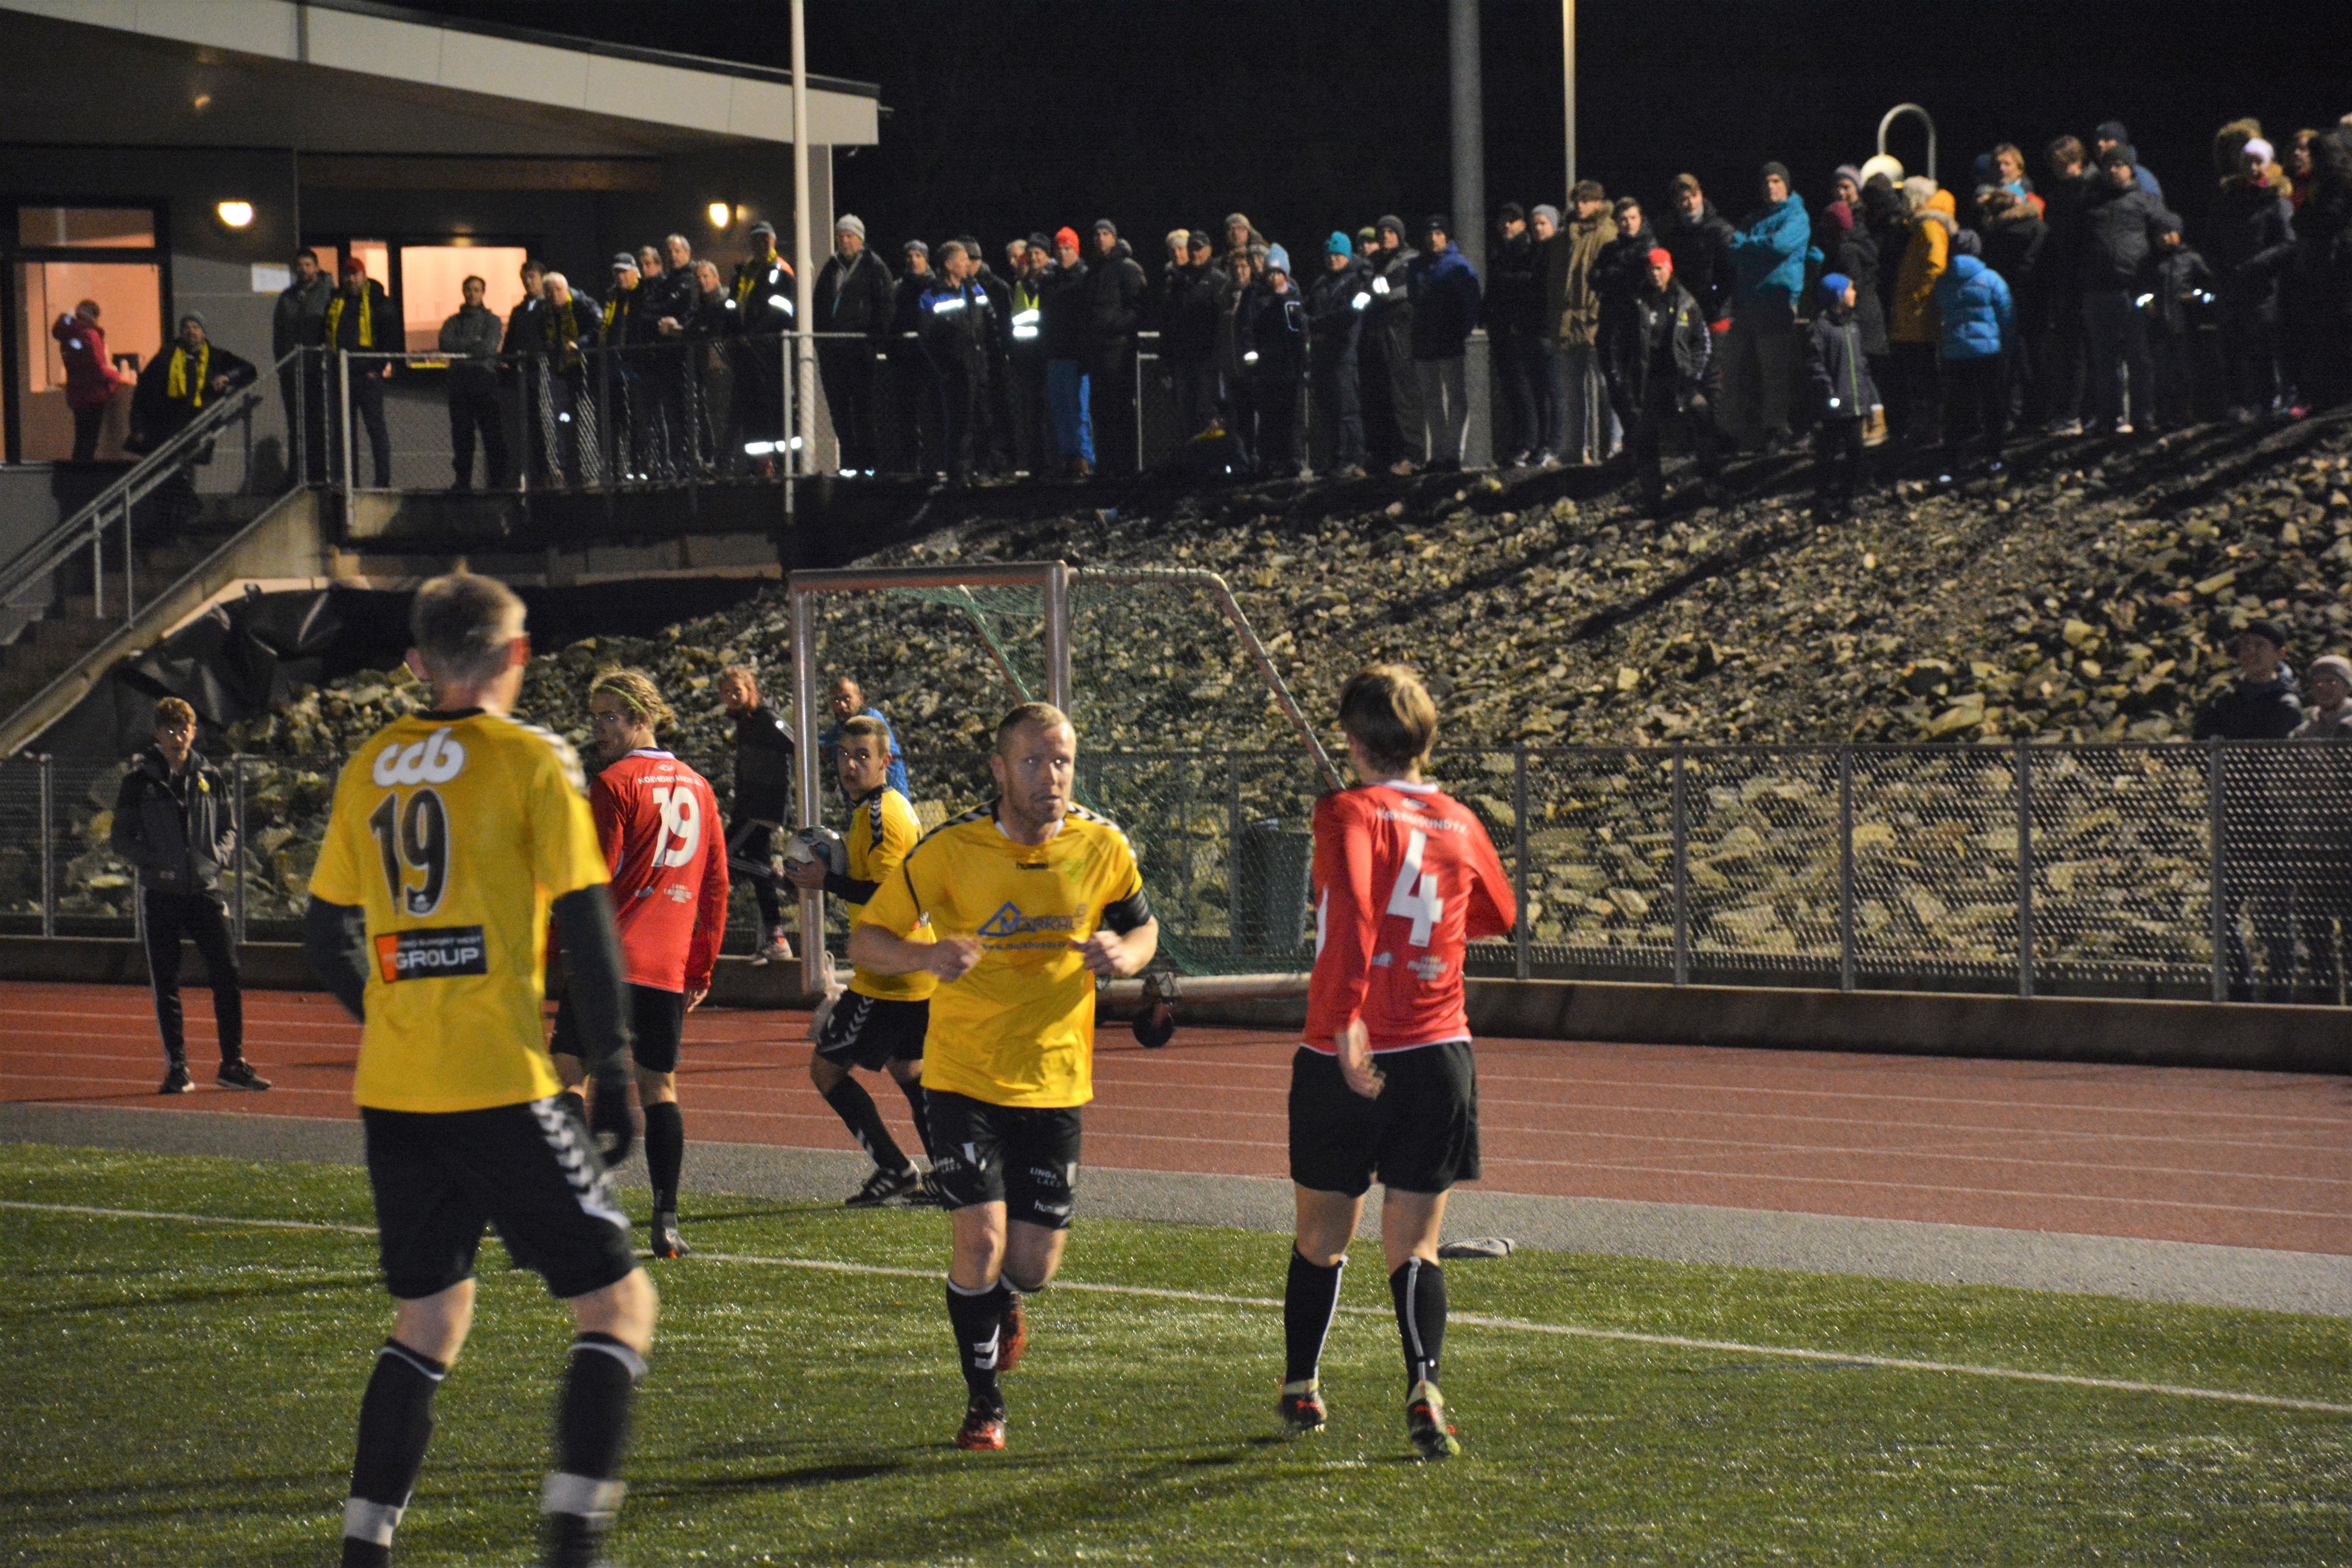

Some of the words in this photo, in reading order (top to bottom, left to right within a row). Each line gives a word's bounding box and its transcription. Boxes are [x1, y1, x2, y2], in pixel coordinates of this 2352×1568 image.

[367, 786, 450, 918] 19
[651, 786, 701, 867] 19
[1386, 828, 1444, 947] 4
[395, 946, 479, 970] GROUP
